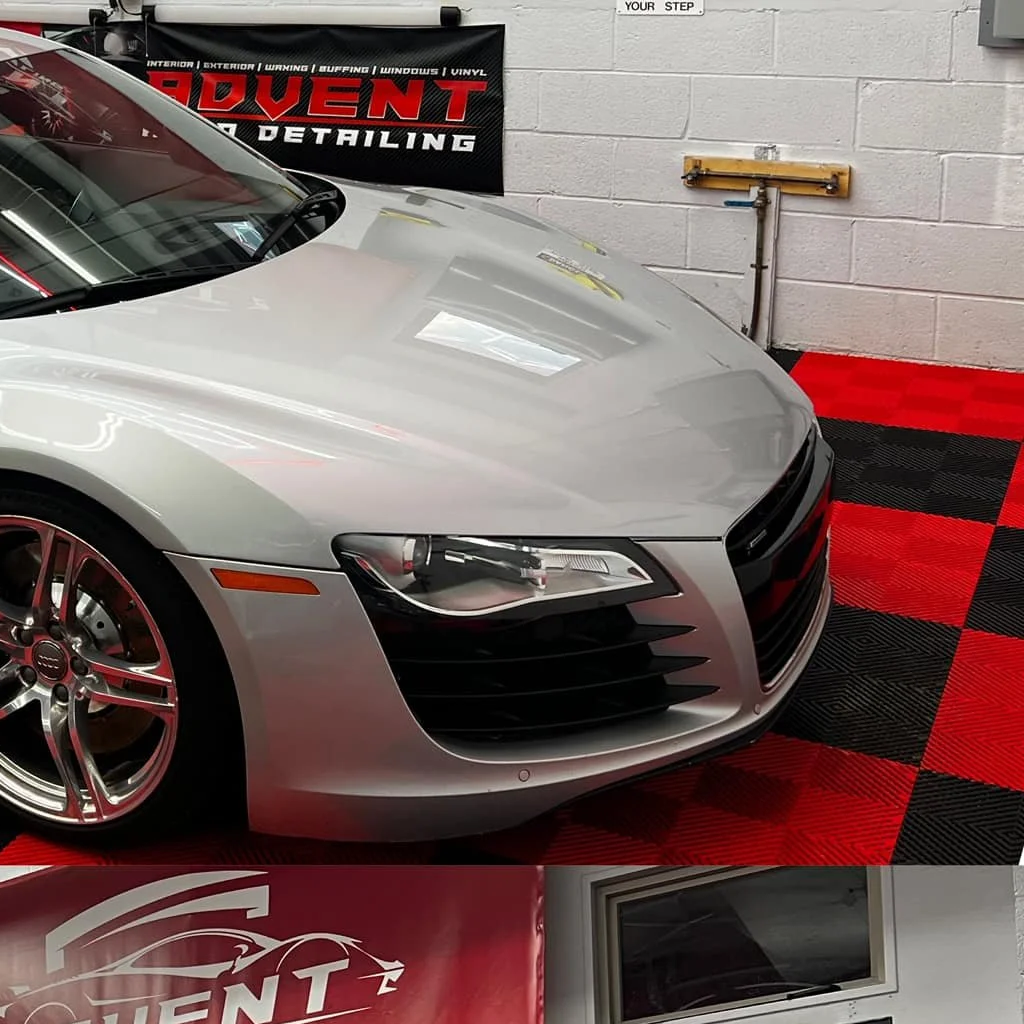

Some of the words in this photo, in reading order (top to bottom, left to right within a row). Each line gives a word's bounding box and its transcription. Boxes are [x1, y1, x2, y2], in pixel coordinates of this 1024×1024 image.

[625, 2, 655, 11] YOUR
[664, 2, 694, 11] STEP
[146, 60, 194, 68] INTERIOR
[203, 62, 255, 70] EXTERIOR
[264, 64, 308, 72] WAXING
[319, 66, 369, 74] BUFFING
[380, 67, 439, 76] WINDOWS
[451, 68, 488, 77] VINYL
[147, 70, 488, 122] ADVENT
[258, 125, 476, 152] DETAILING
